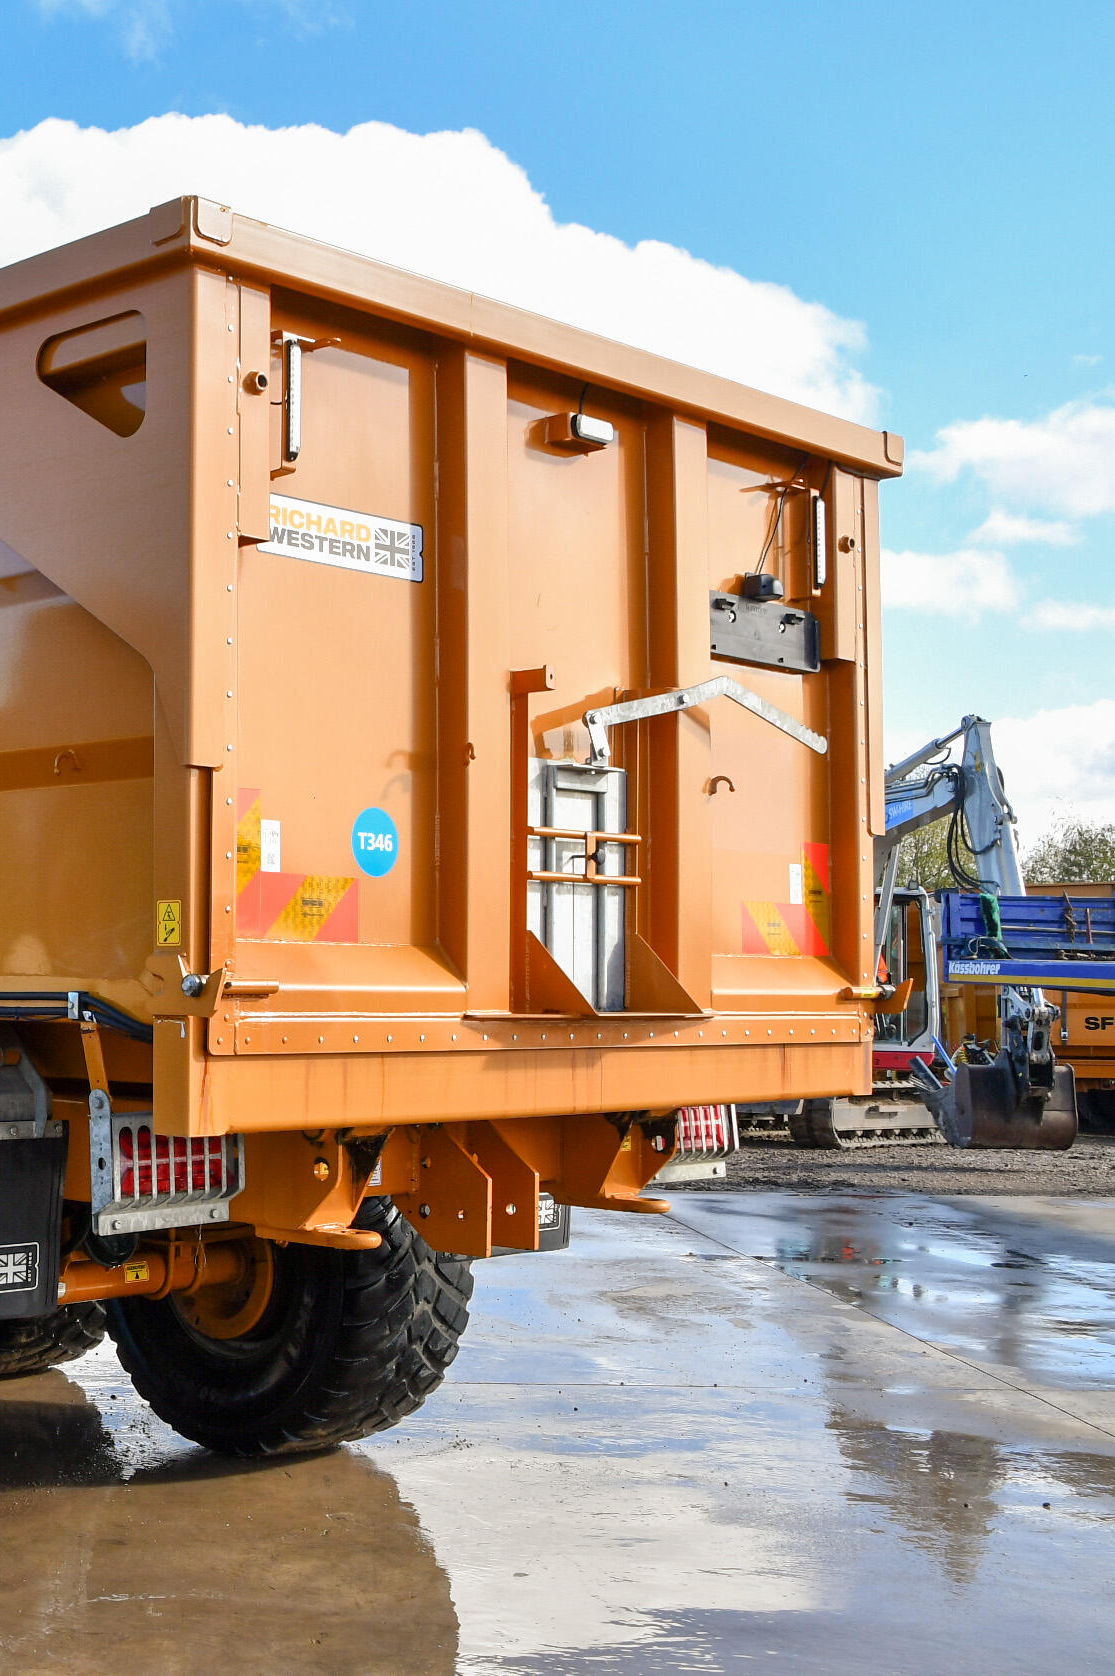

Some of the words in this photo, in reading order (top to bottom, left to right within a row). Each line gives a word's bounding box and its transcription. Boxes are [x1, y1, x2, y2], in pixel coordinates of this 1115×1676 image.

[270, 505, 372, 543] RICHARD
[270, 527, 371, 562] WESTERN
[358, 832, 393, 851] T346
[1085, 1016, 1115, 1031] SF
